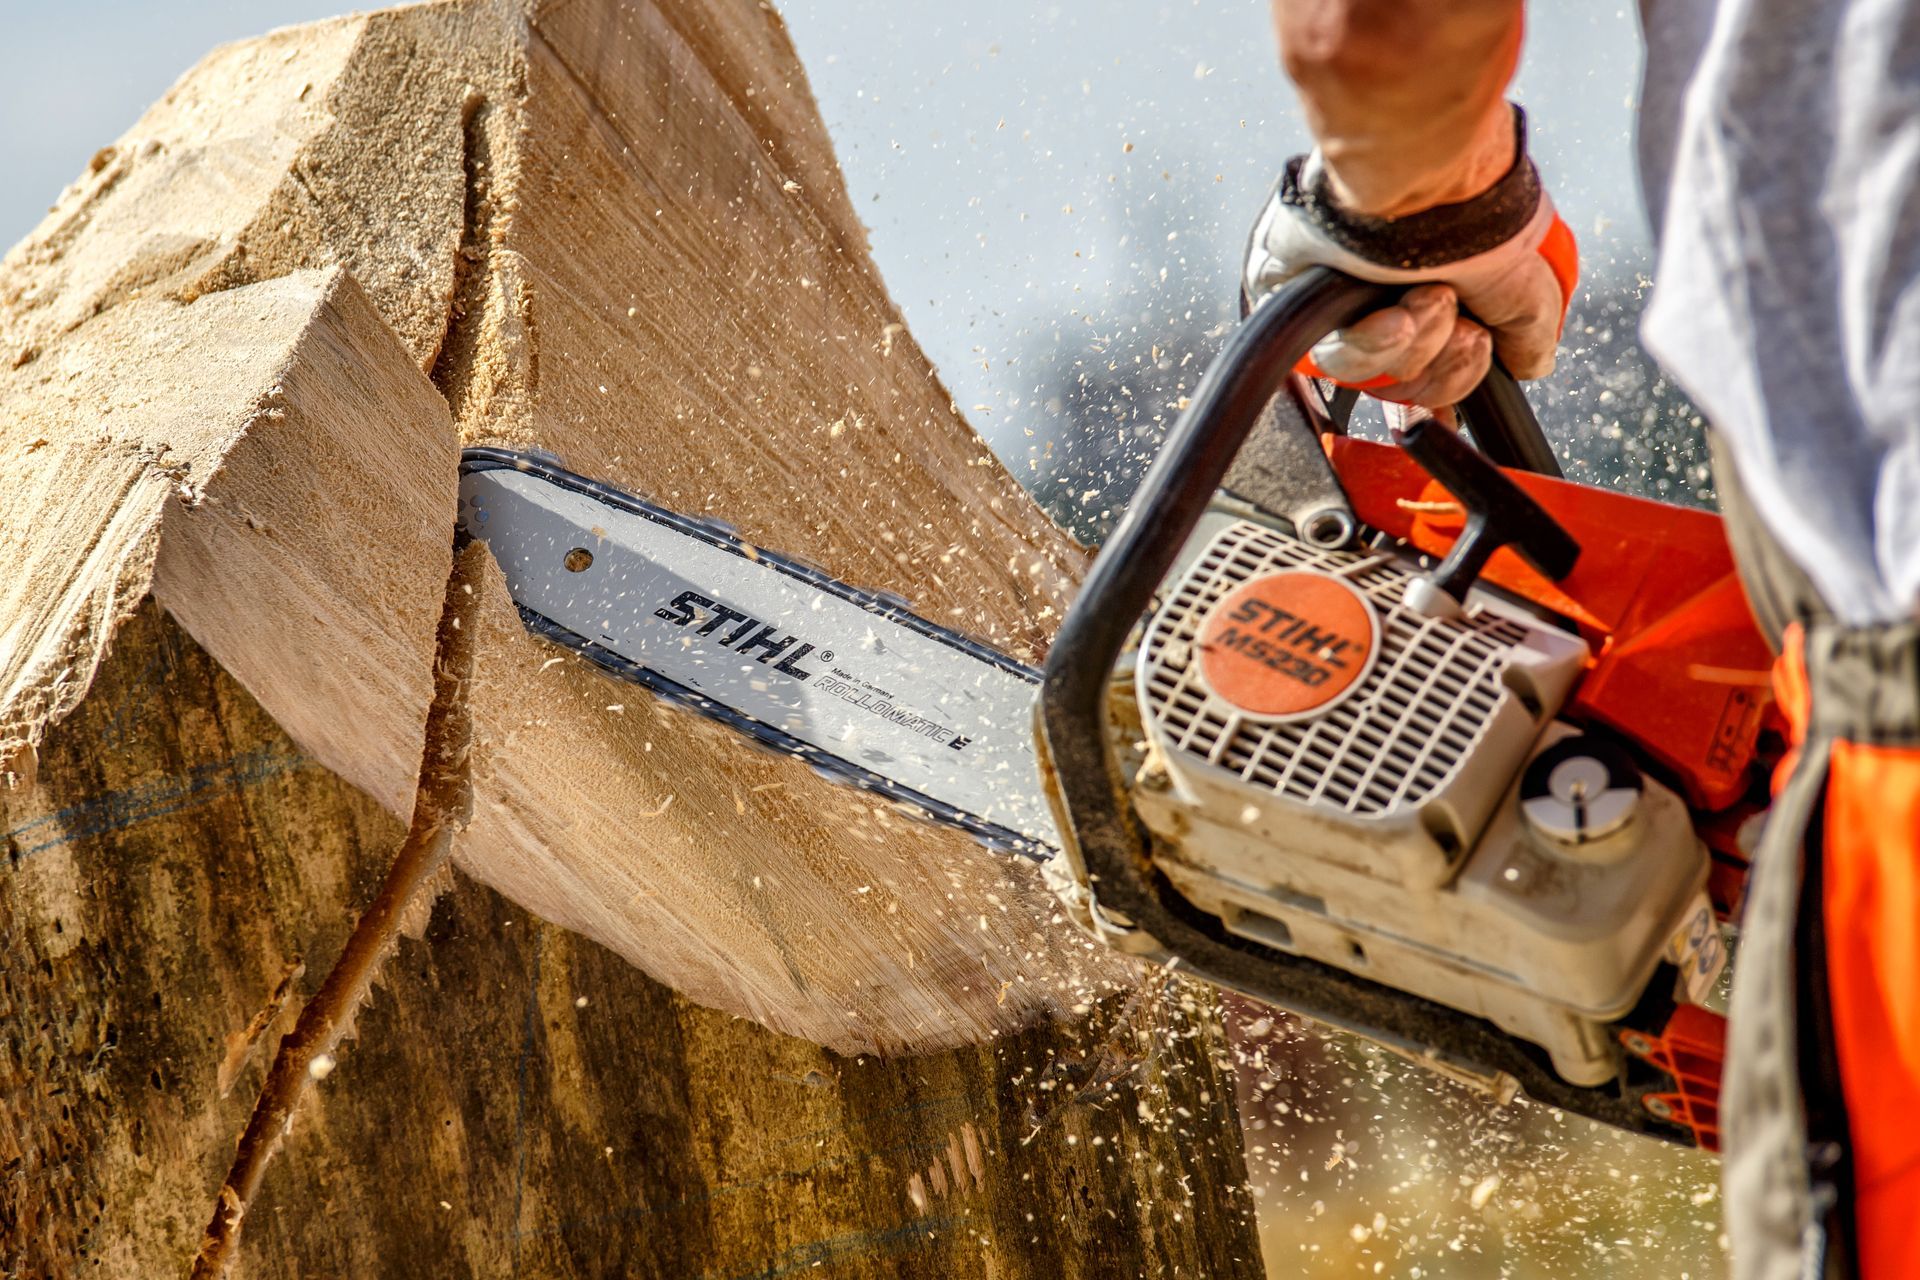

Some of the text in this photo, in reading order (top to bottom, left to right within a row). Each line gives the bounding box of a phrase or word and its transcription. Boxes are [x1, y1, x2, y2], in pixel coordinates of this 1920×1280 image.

[654, 590, 816, 681] STIHL
[1228, 597, 1350, 669] STIHL
[814, 675, 955, 743] ROLLOMATIC
[831, 667, 853, 680] Made
[861, 681, 895, 700] Germany
